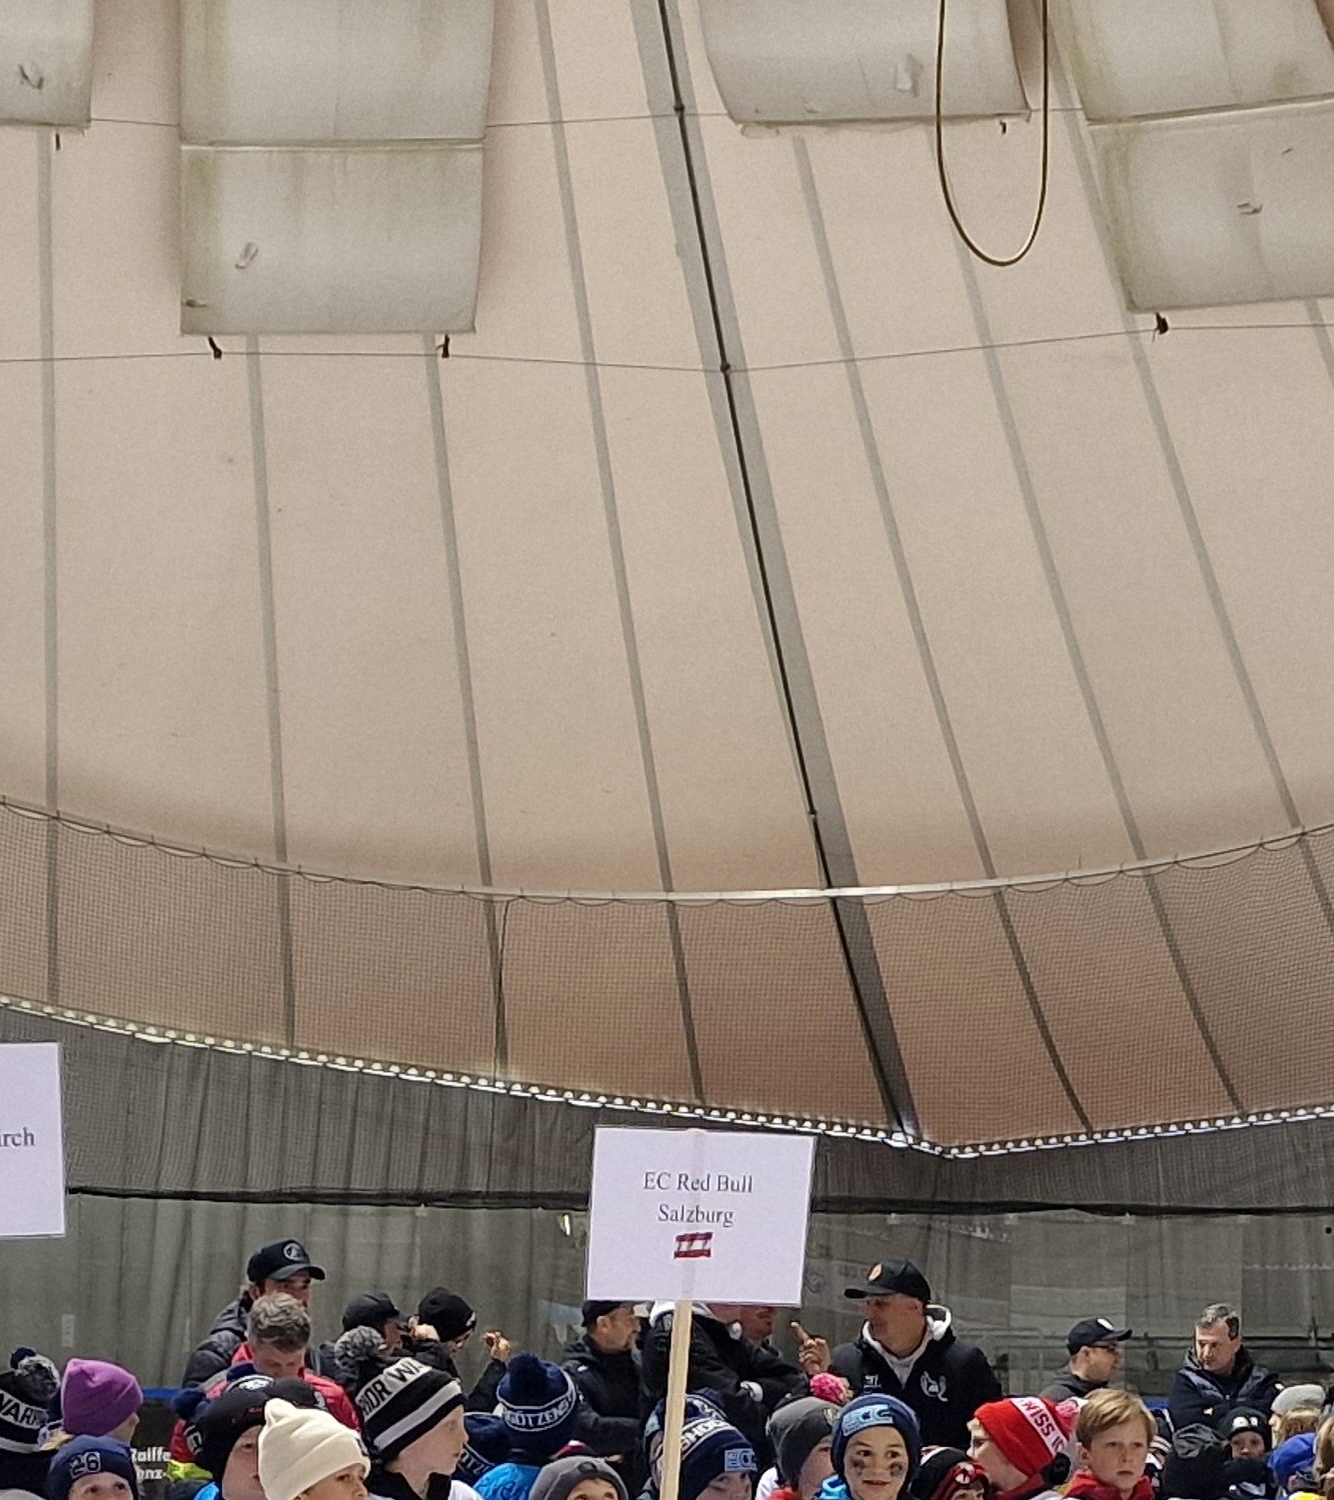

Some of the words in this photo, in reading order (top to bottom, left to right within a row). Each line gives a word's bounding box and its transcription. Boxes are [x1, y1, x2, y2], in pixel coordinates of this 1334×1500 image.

[643, 1171, 671, 1190] EC
[677, 1174, 711, 1192] Red
[716, 1175, 754, 1193] Bull
[657, 1204, 735, 1227] Salzburg
[70, 1451, 103, 1479] 26
